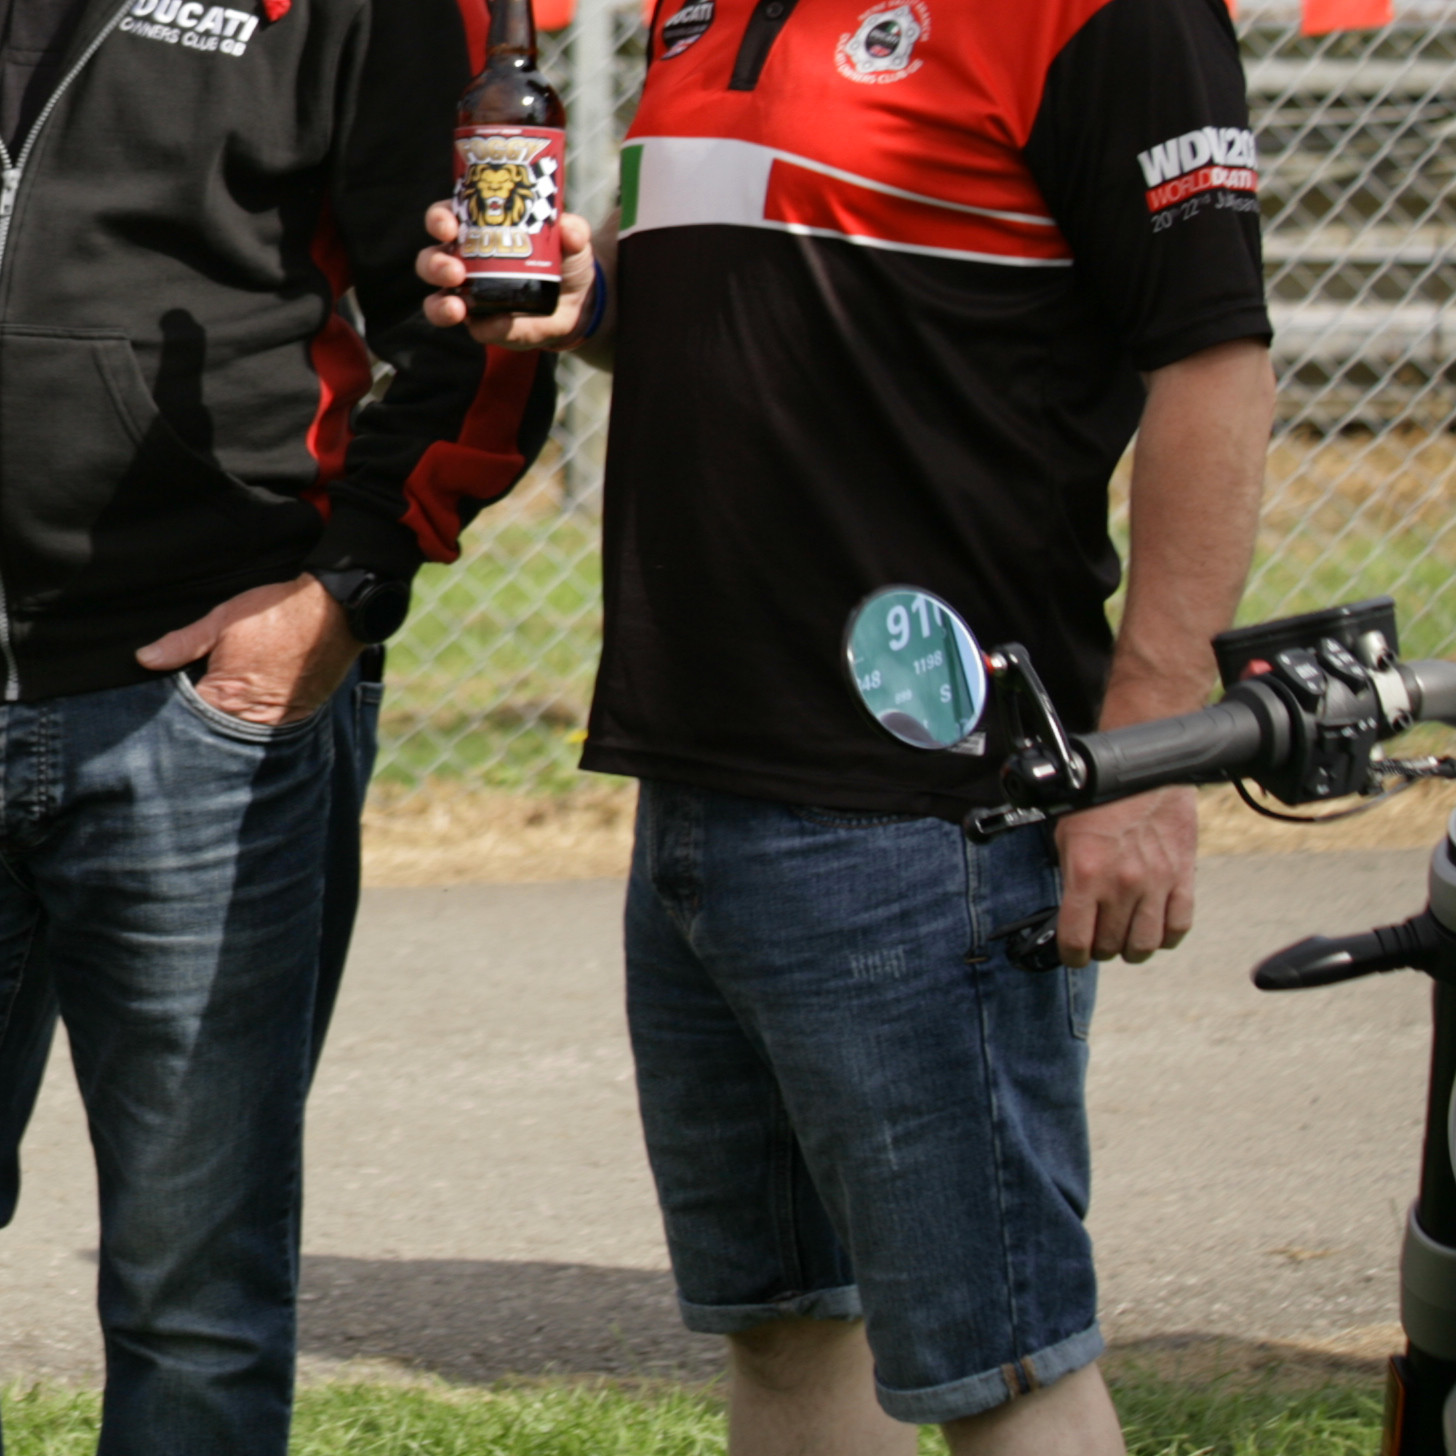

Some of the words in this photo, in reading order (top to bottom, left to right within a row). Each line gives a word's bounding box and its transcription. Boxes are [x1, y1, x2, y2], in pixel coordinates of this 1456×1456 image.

[119, 16, 181, 44] OWNERS
[182, 30, 219, 51] CLUB
[219, 39, 247, 57] GB
[460, 226, 534, 259] GOLD
[913, 650, 943, 675] 1198
